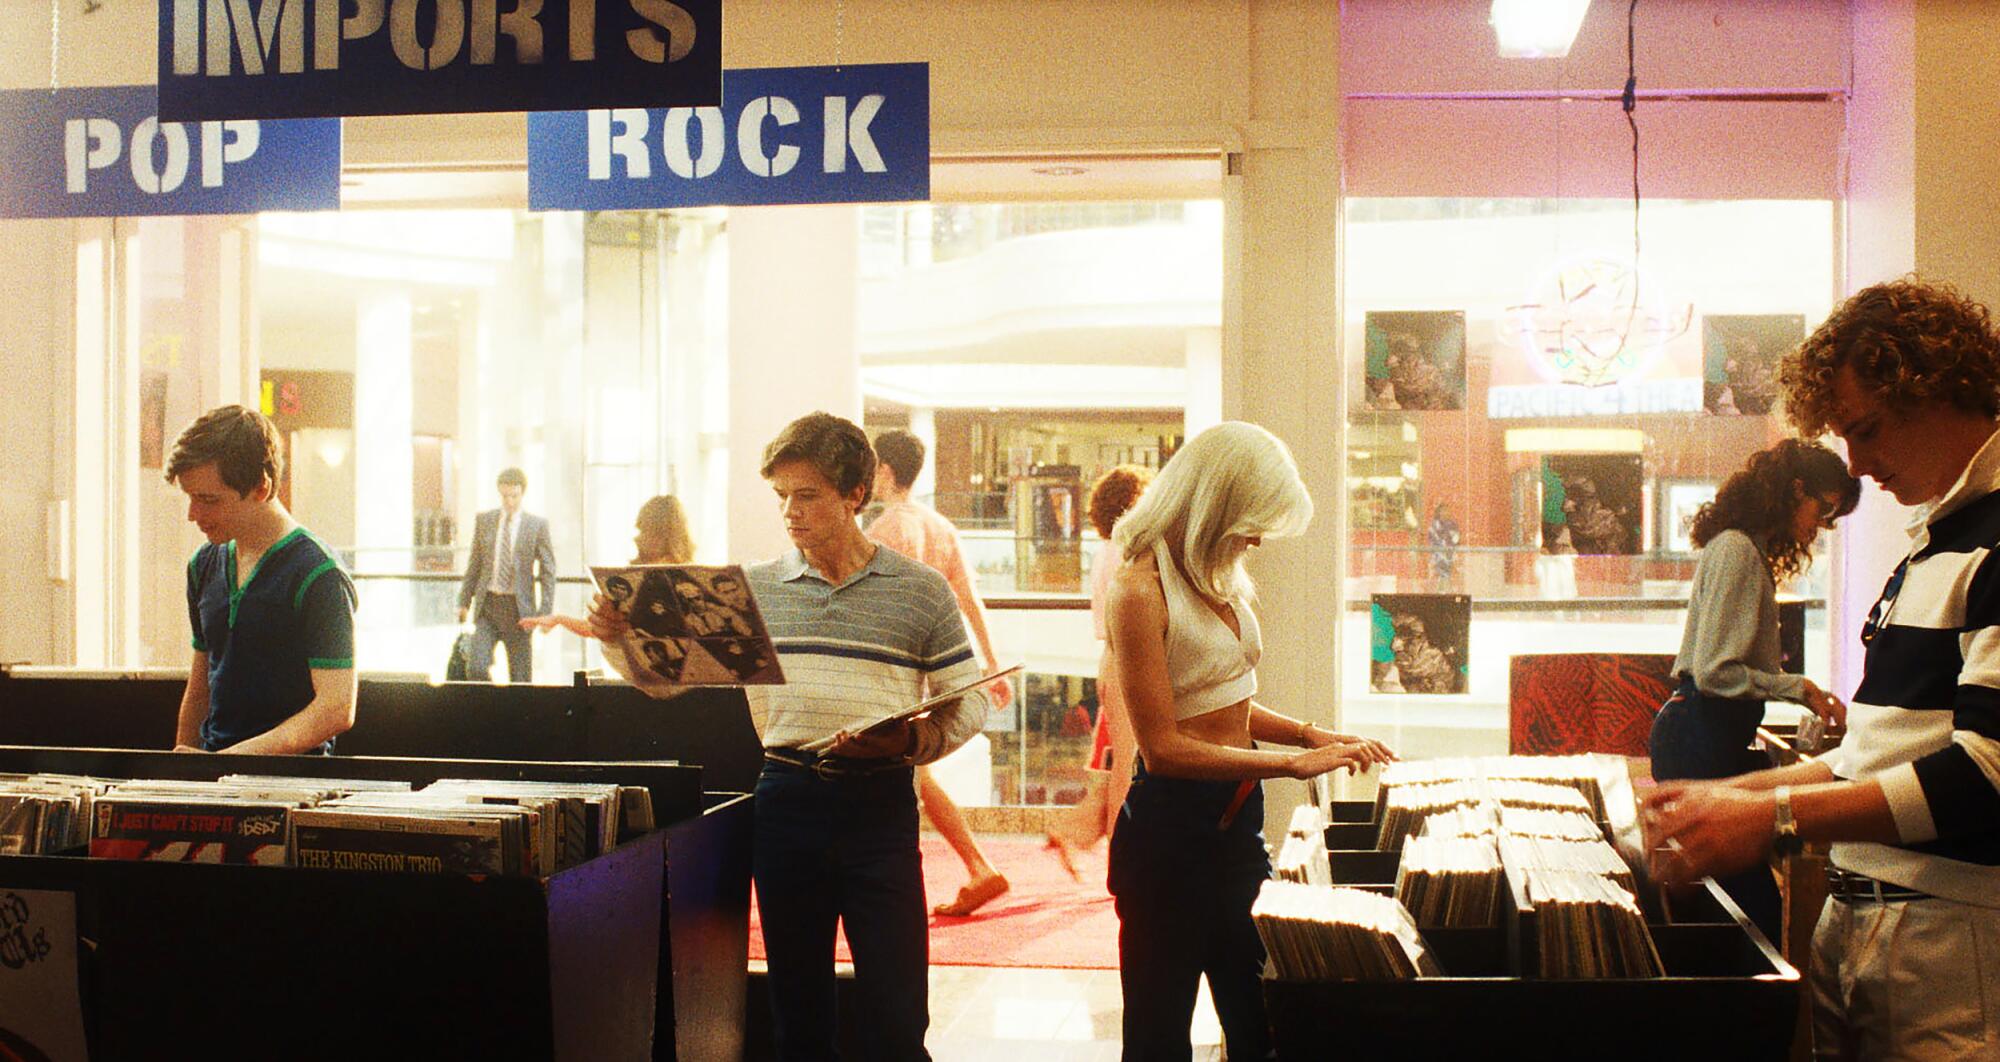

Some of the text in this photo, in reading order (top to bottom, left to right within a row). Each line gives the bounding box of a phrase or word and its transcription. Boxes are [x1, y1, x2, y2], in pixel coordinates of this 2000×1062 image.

[588, 95, 888, 180] ROCK
[64, 115, 261, 194] POP
[1635, 383, 1698, 412] THEA
[119, 813, 150, 831] JUST
[190, 815, 221, 833] STOP
[300, 849, 442, 875] THE KINGSTON TRIO
